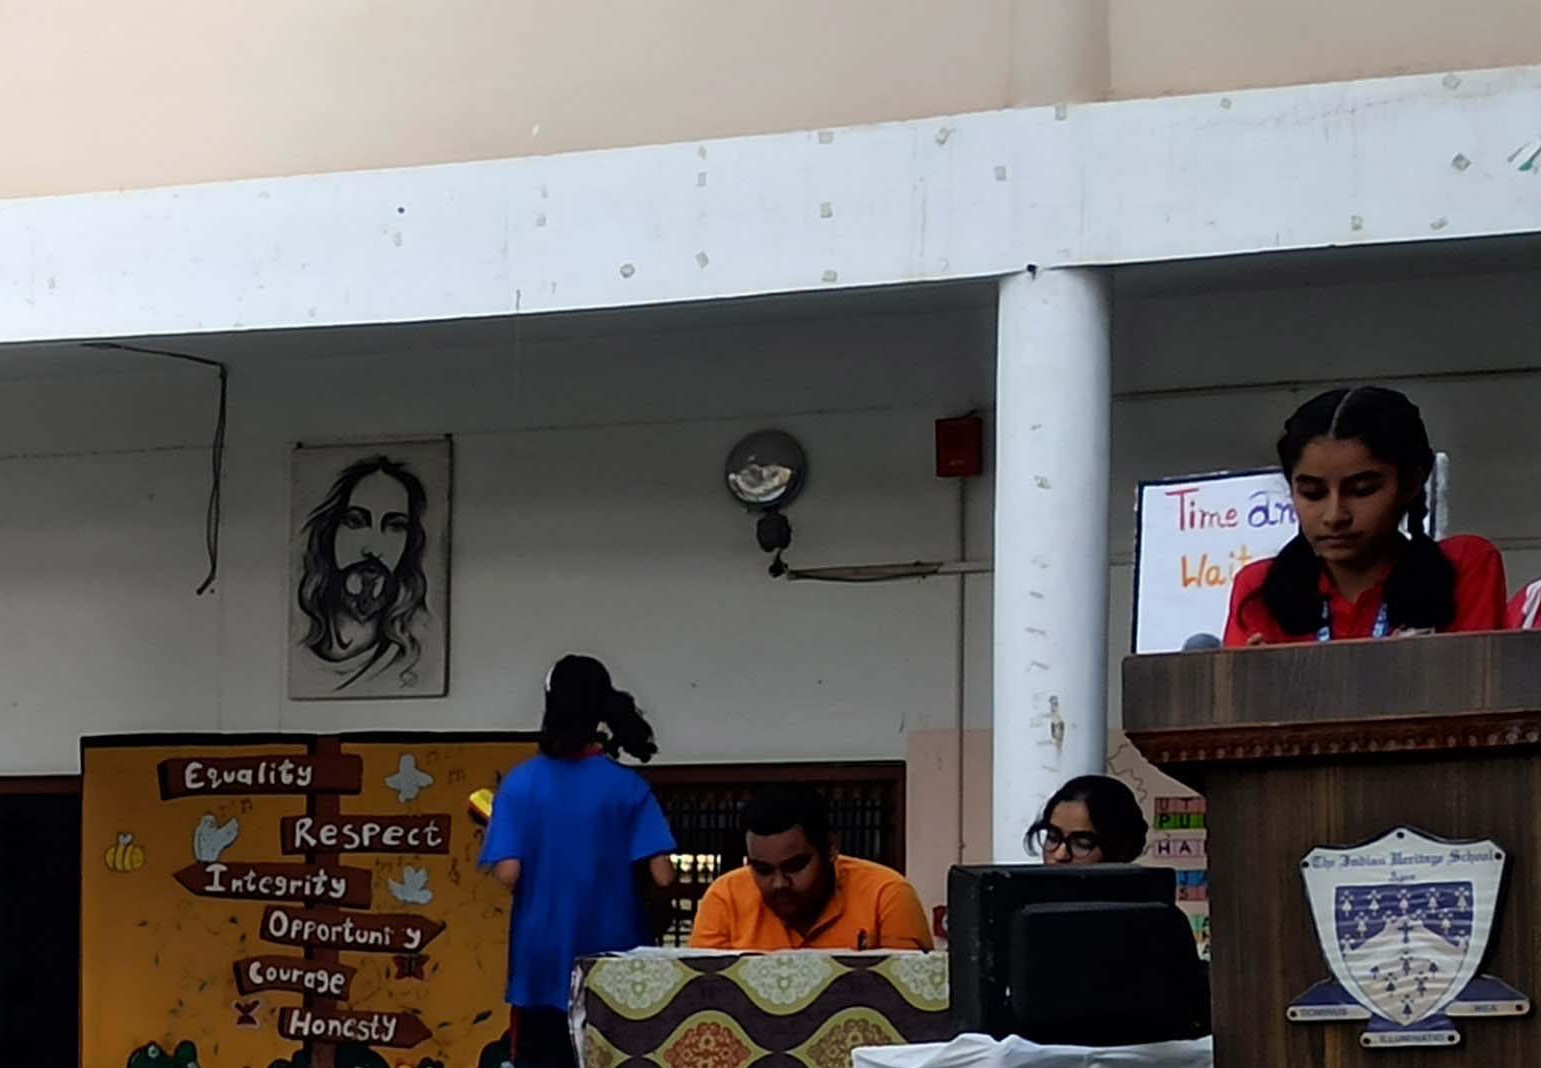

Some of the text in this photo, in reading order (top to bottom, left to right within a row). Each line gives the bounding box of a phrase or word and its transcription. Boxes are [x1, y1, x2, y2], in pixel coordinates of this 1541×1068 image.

[1165, 488, 1297, 531] Time an
[184, 759, 312, 789] Equality
[295, 818, 442, 849] Respect
[1449, 849, 1494, 865] School
[204, 863, 346, 898] Integrity
[269, 910, 421, 949] Opportuniy
[249, 961, 345, 995] Courage
[289, 1010, 397, 1042] Honesty
